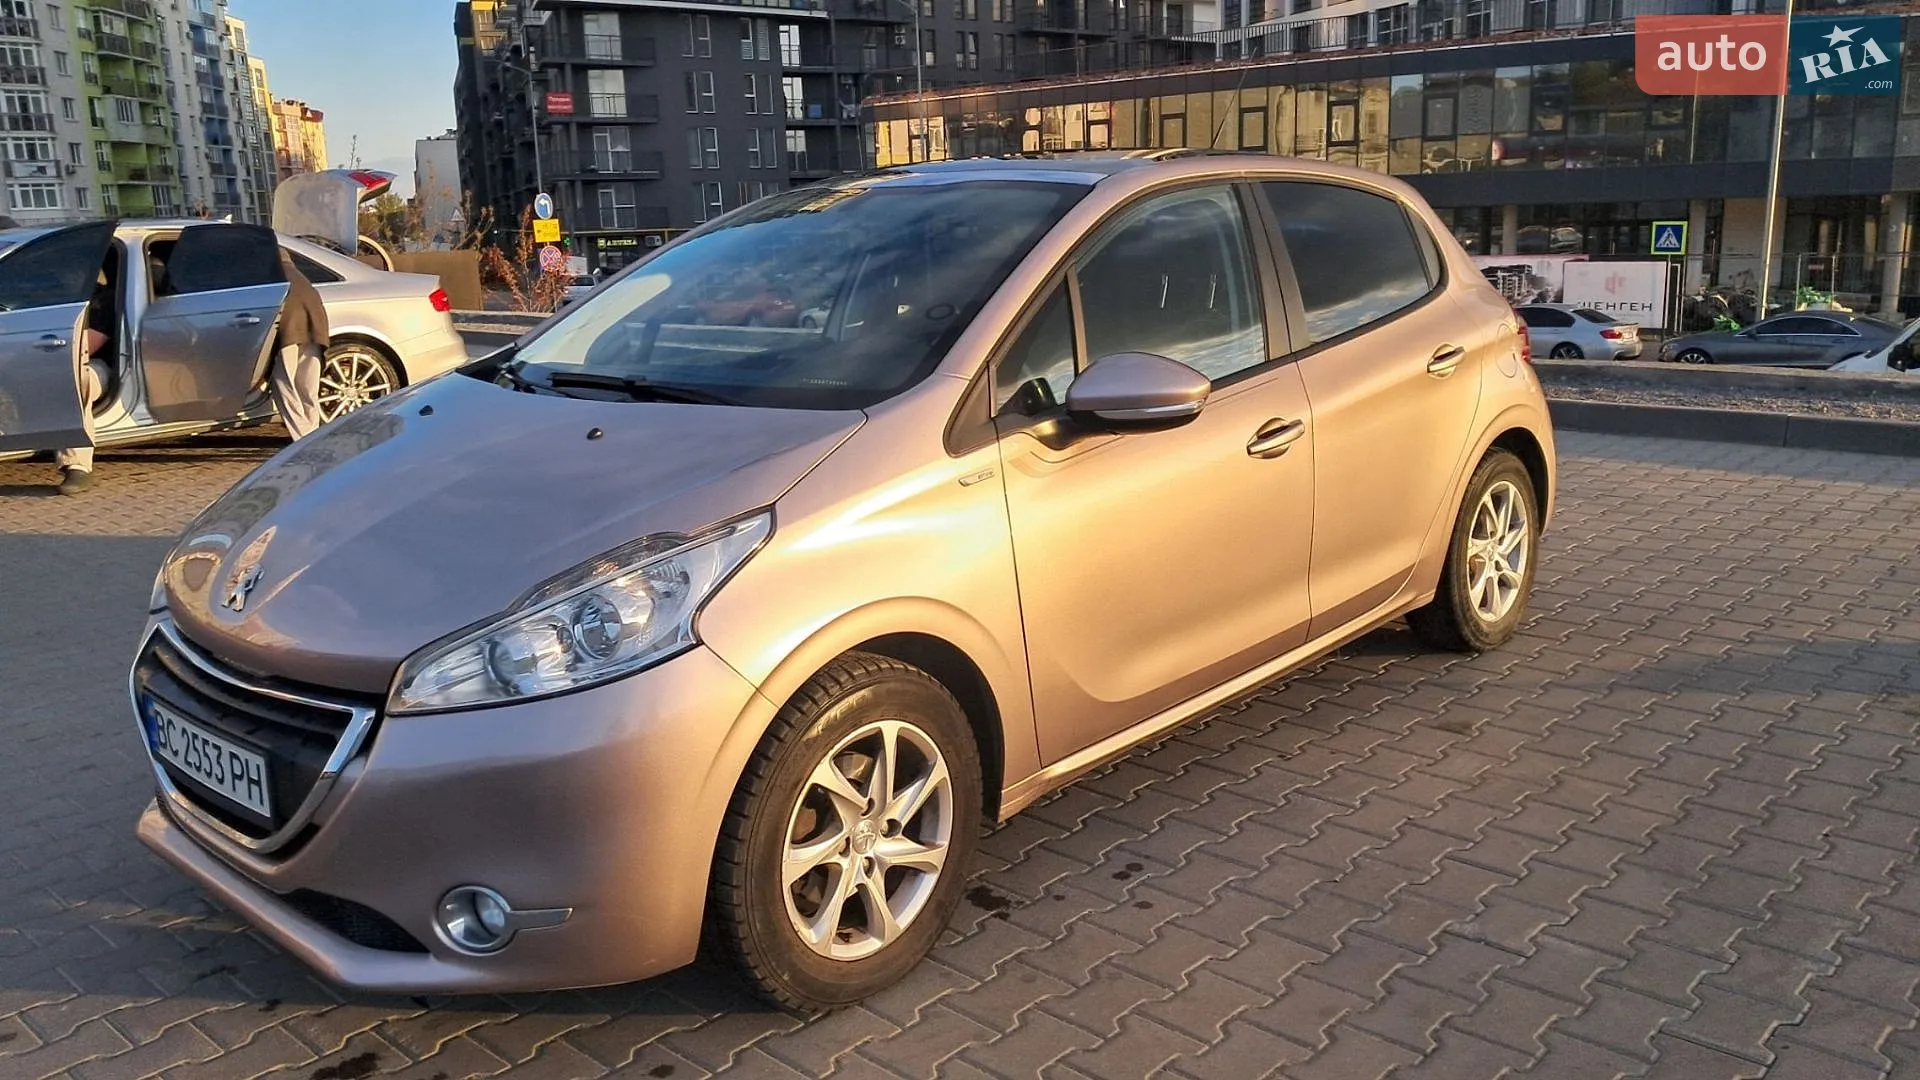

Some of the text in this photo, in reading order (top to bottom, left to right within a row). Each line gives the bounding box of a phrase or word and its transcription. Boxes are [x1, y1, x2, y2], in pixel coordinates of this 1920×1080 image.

[154, 709, 264, 806] BC 2553 PH
